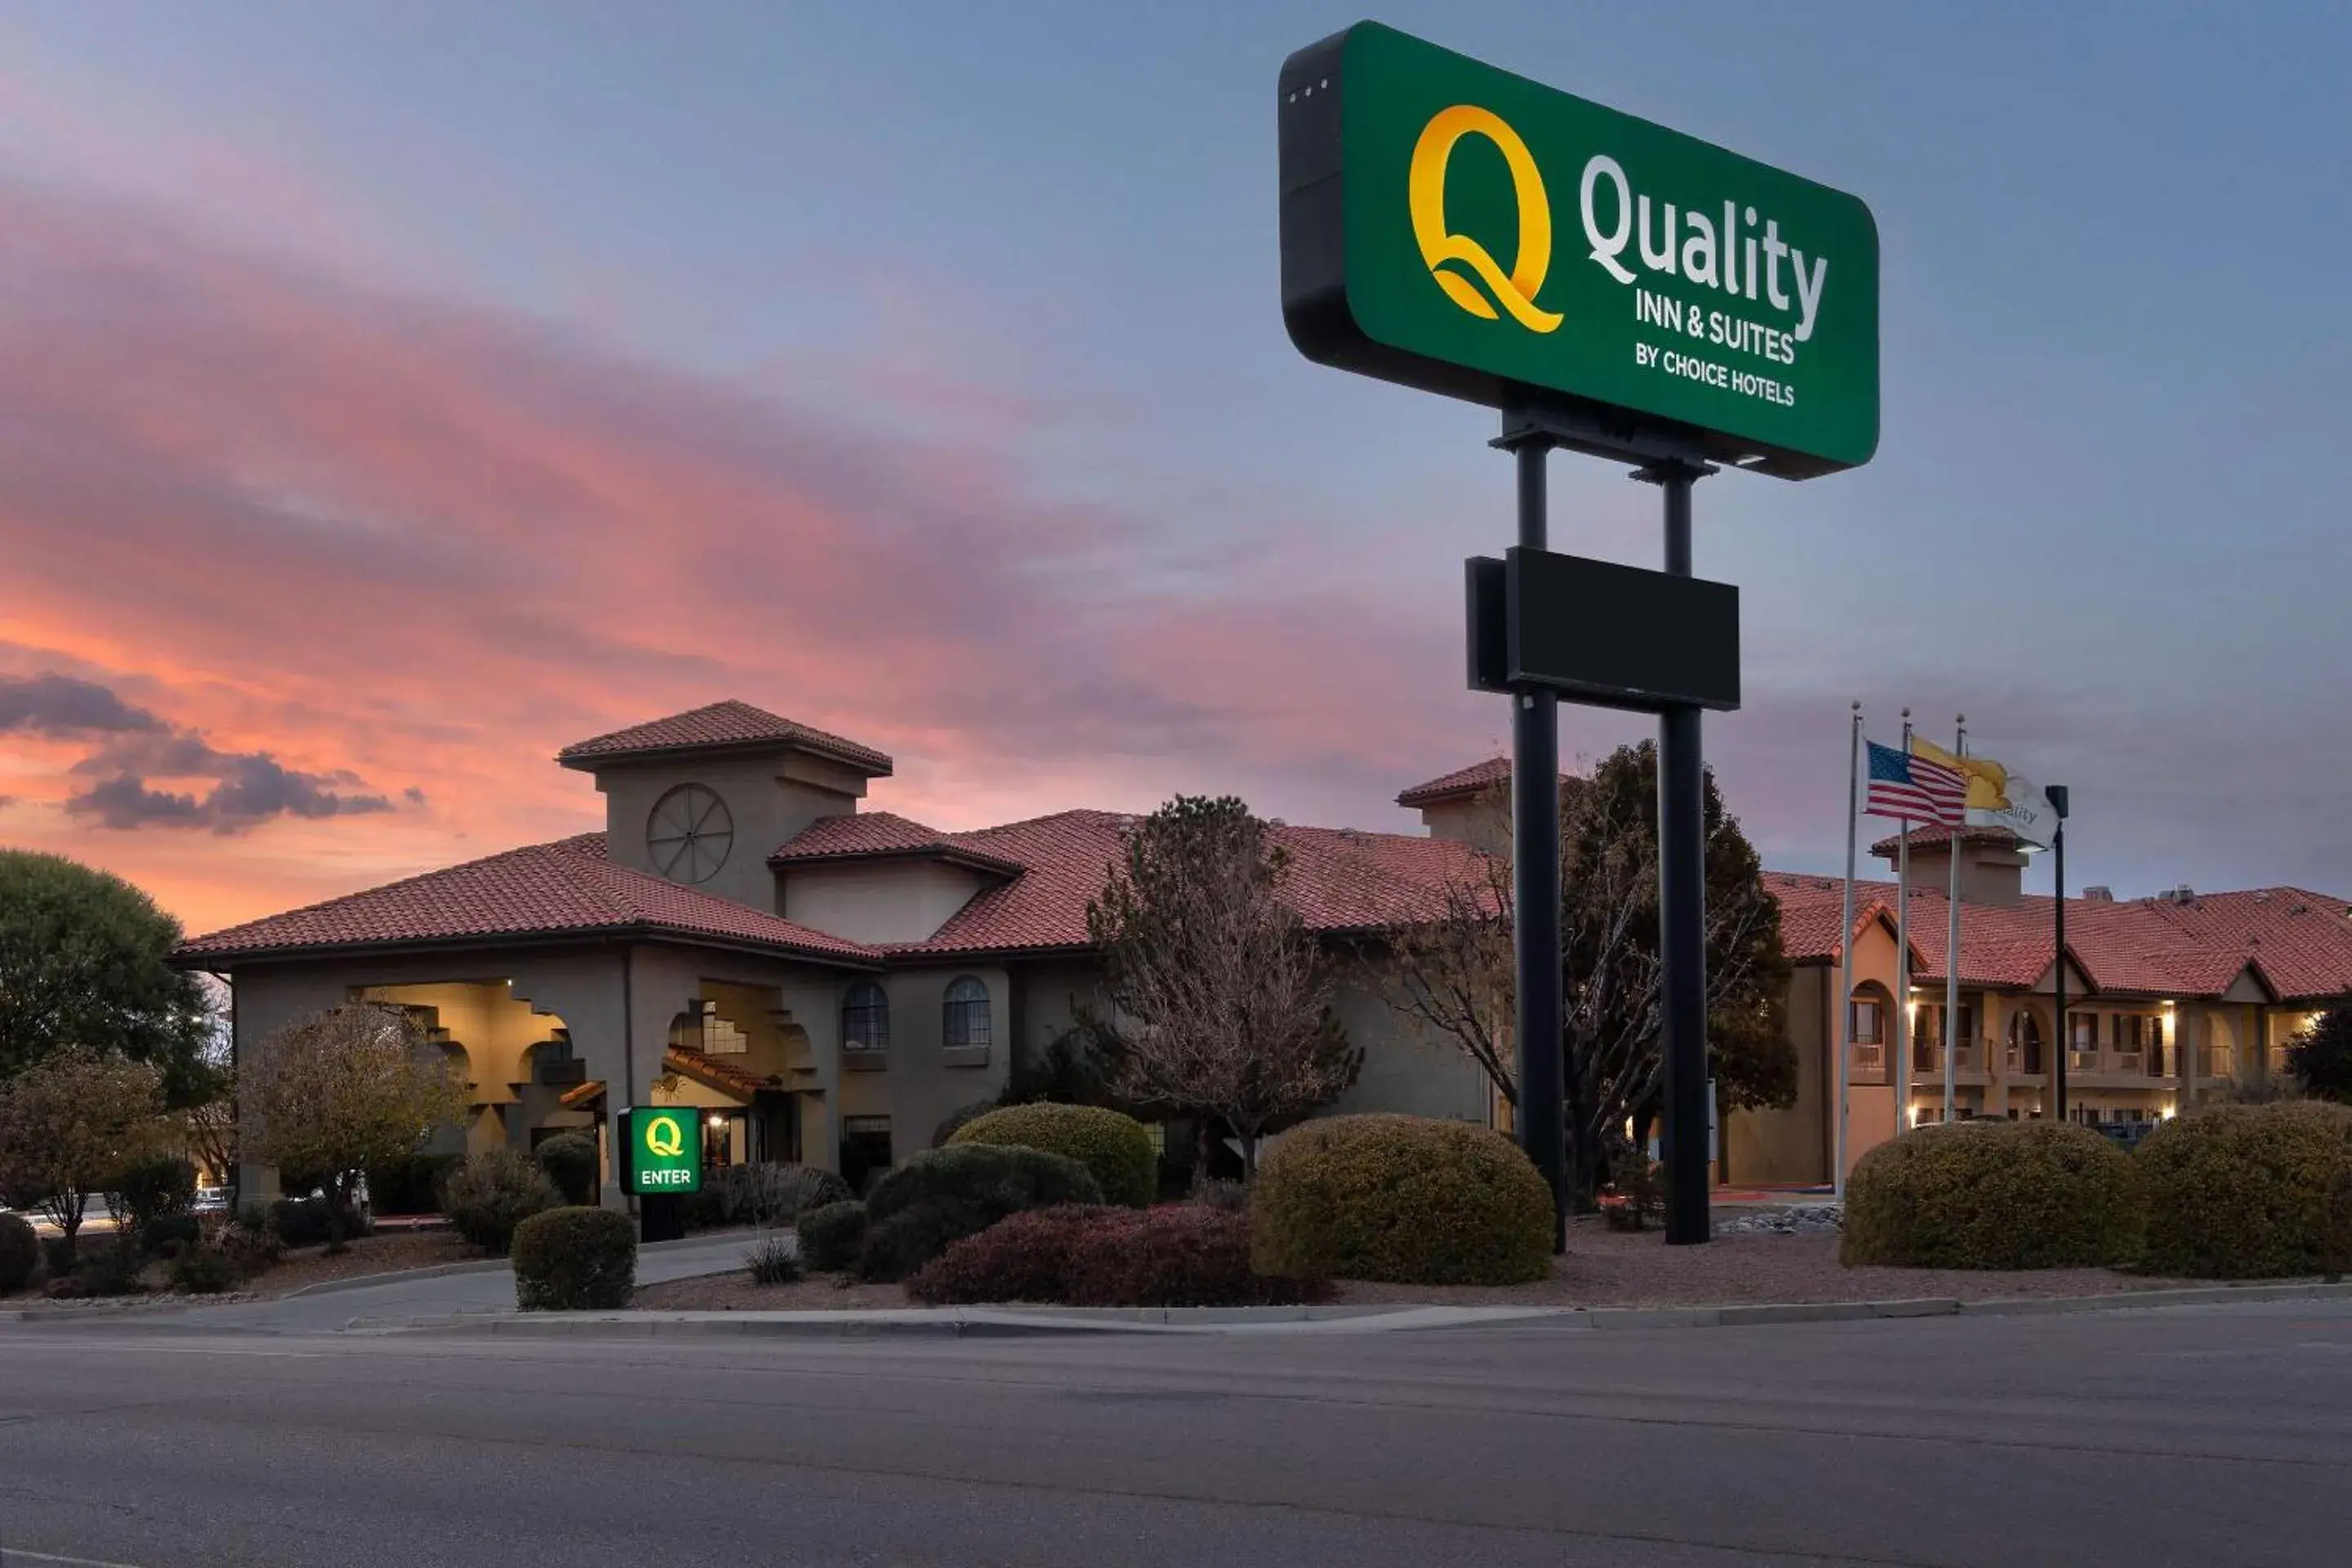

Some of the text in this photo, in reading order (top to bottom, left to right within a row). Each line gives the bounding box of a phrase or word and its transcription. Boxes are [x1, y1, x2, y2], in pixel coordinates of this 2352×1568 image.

[1410, 105, 1564, 333] Q
[1580, 154, 1828, 342] Quality
[1636, 287, 1795, 365] INN & SUITES
[1636, 342, 1795, 407] BY CHOICE HOTELS
[646, 1116, 684, 1156] Q
[642, 1169, 691, 1185] ENTER
